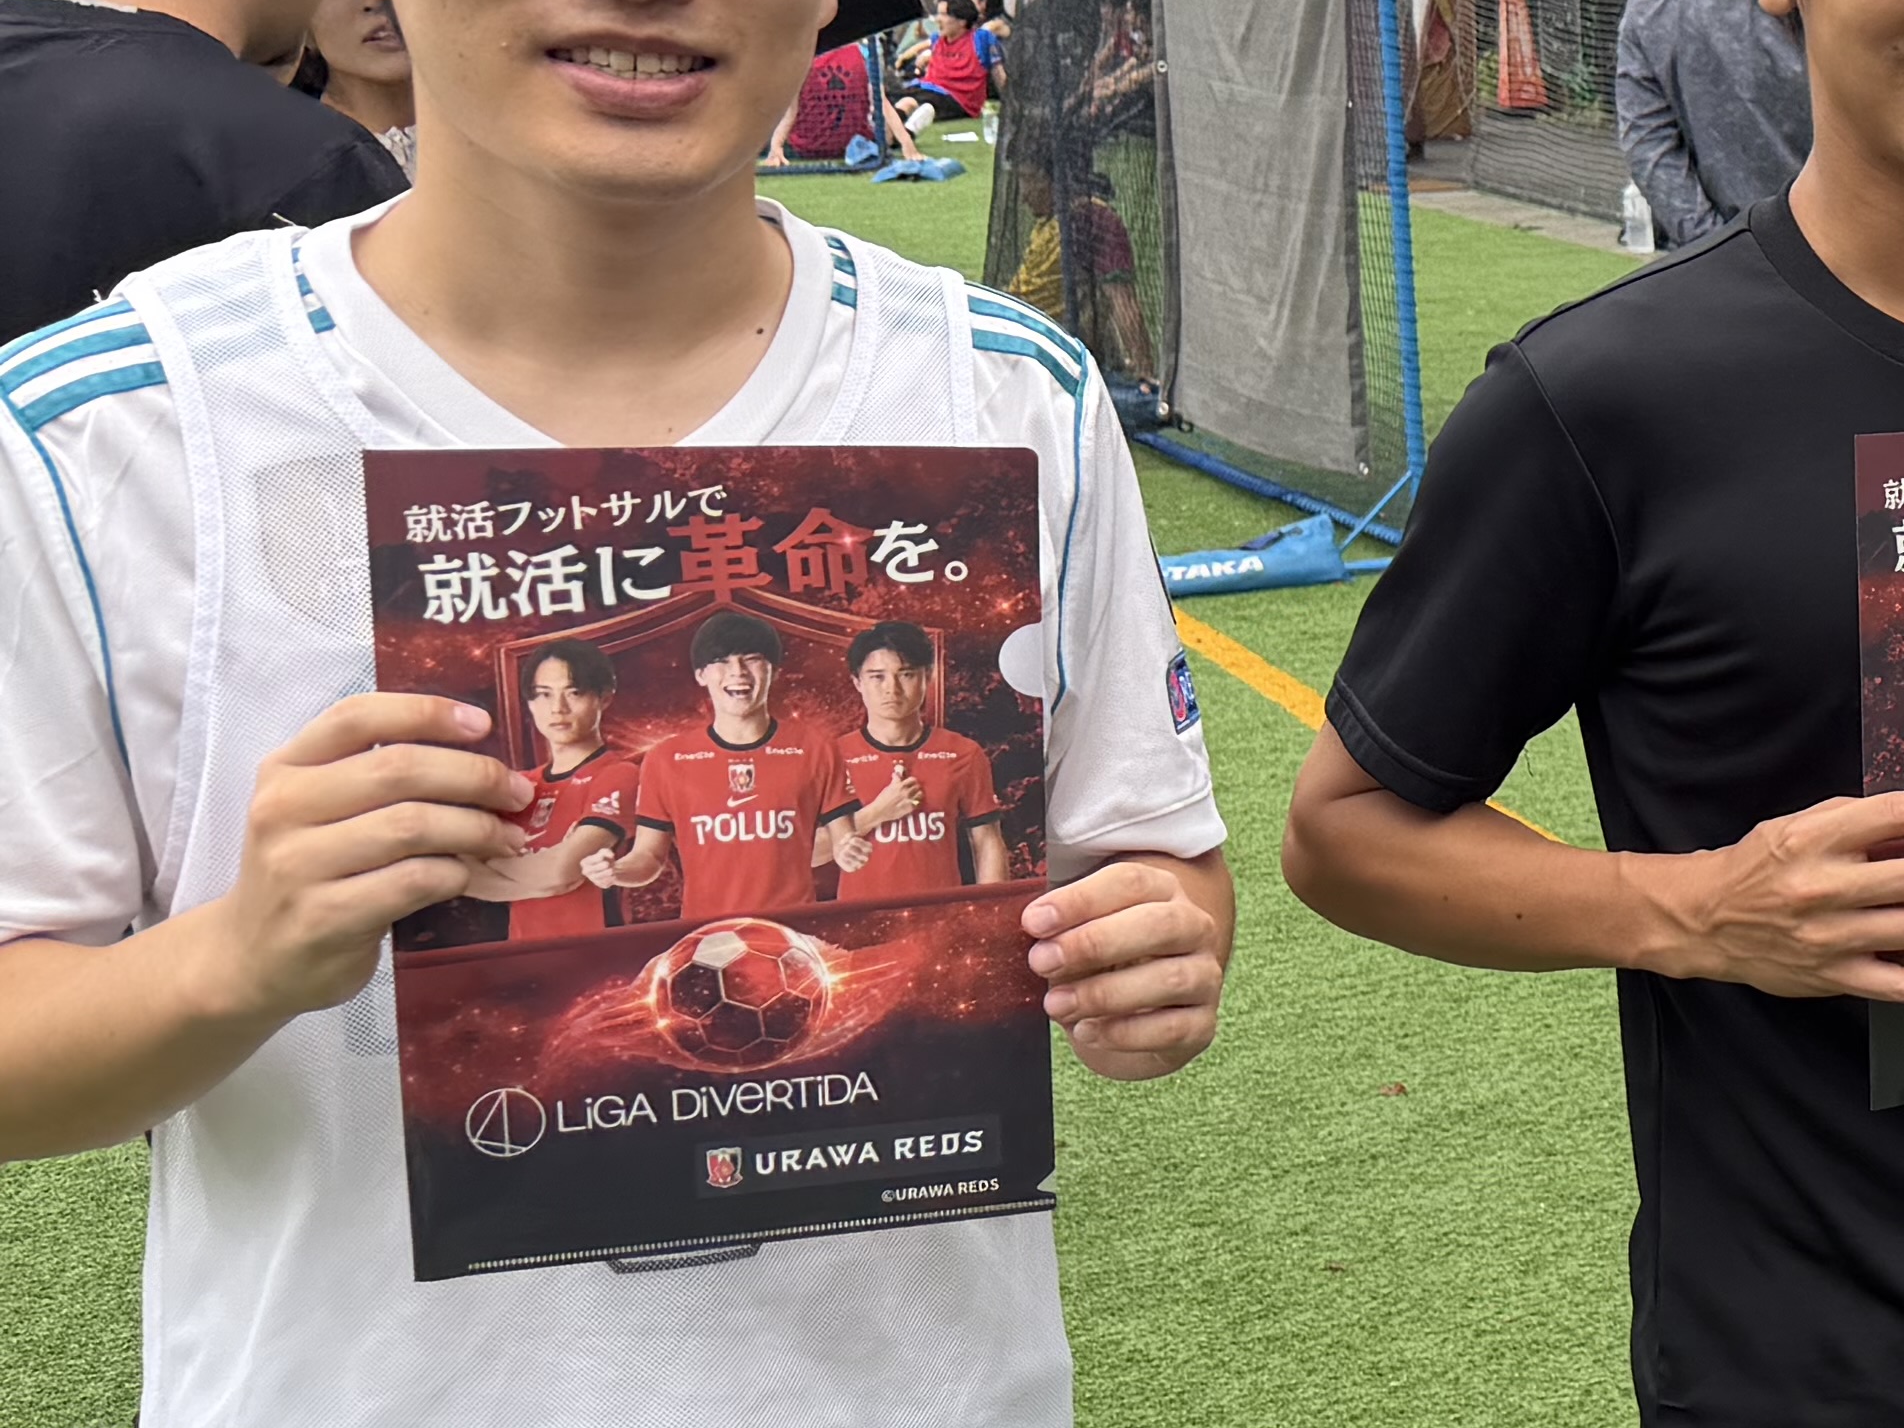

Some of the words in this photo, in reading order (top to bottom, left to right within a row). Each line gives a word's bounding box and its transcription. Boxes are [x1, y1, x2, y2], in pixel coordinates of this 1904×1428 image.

[405, 485, 727, 543] 就活フットサルで
[422, 507, 968, 624] 就活に革命を。
[1165, 556, 1264, 581] TAKA
[692, 810, 796, 844] POLUS
[876, 811, 945, 842] OLUS
[756, 1139, 880, 1175] URAWA
[894, 1129, 983, 1160] REDS
[958, 1179, 1000, 1196] REDS
